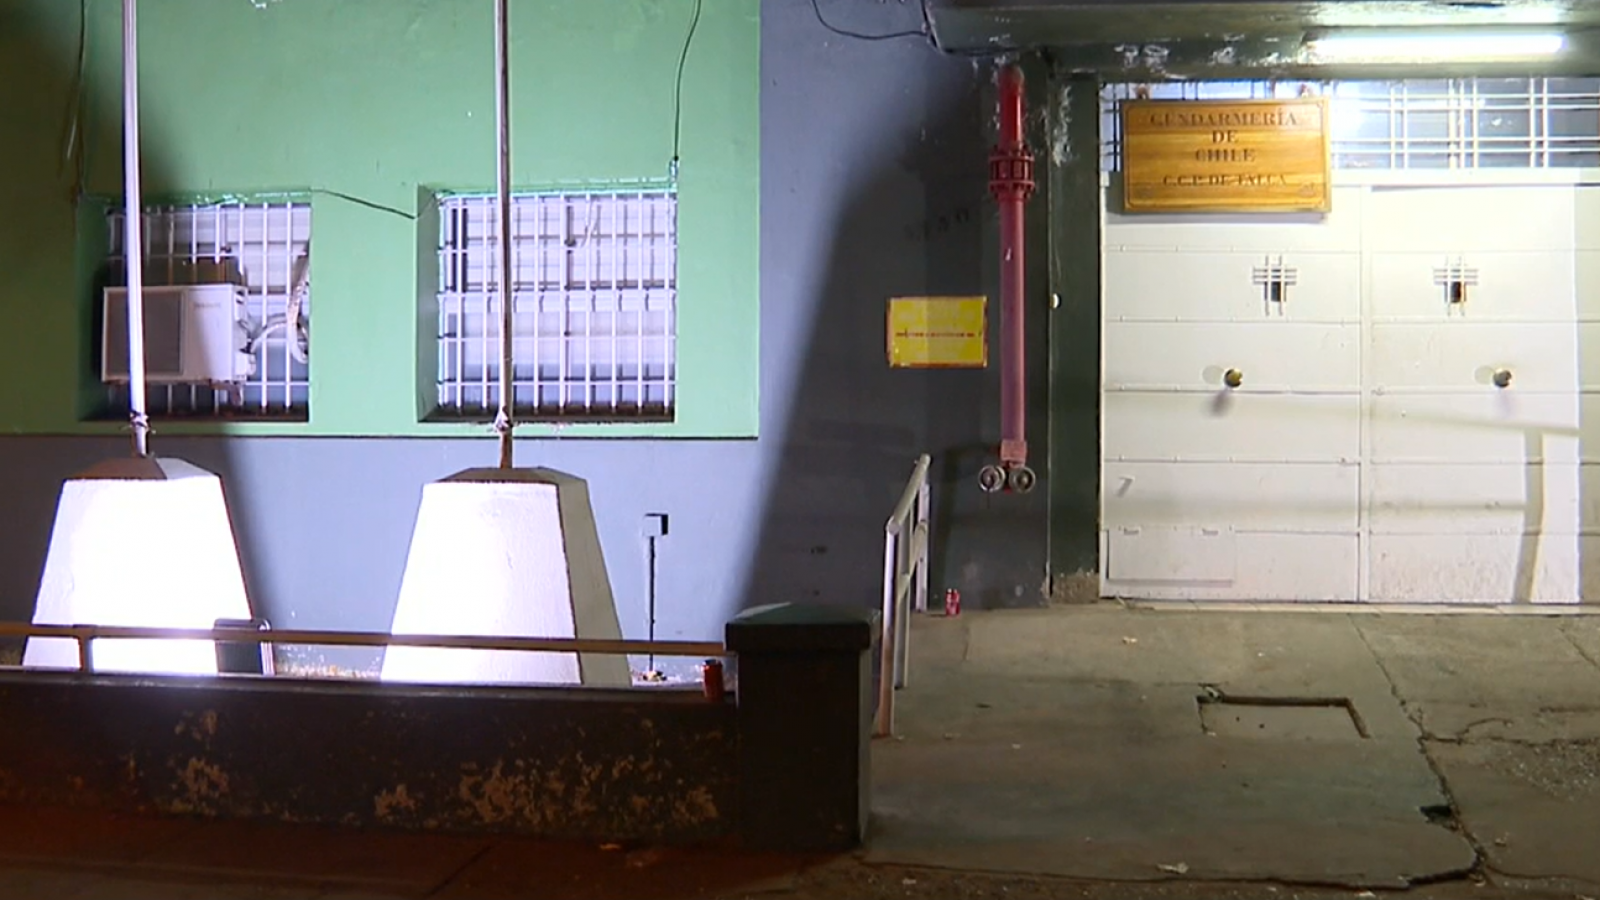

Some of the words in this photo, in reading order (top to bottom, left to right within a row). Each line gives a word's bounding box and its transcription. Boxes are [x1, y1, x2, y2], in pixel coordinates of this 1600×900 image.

[1150, 109, 1297, 126] GENDARMERÍA
[1212, 129, 1238, 143] DE
[1195, 149, 1256, 162] CHILE
[1208, 174, 1229, 186] DE
